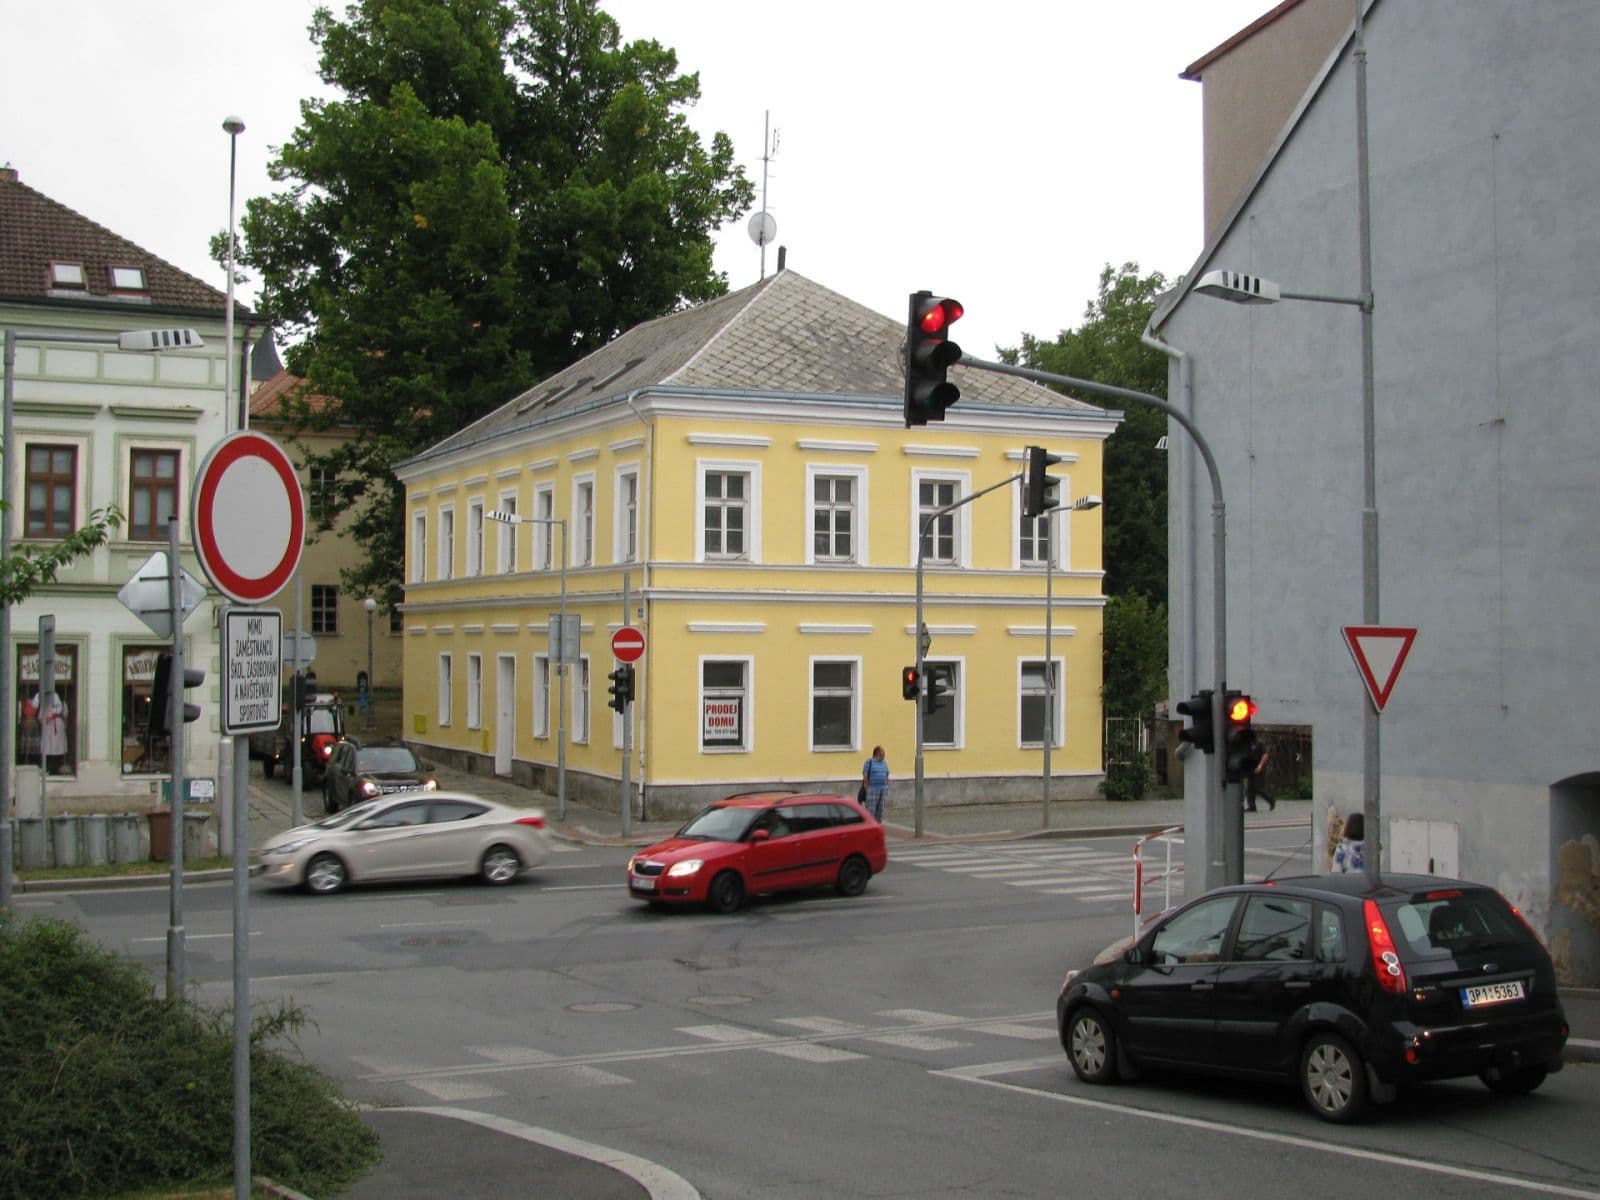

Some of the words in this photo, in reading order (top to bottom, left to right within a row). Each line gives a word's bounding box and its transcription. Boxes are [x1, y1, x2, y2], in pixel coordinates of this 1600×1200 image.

[247, 618, 263, 634] MIMO
[234, 687, 239, 701] A
[705, 704, 737, 715] PRODEJ
[708, 716, 735, 728] DOMU
[1494, 984, 1519, 1000] 5363
